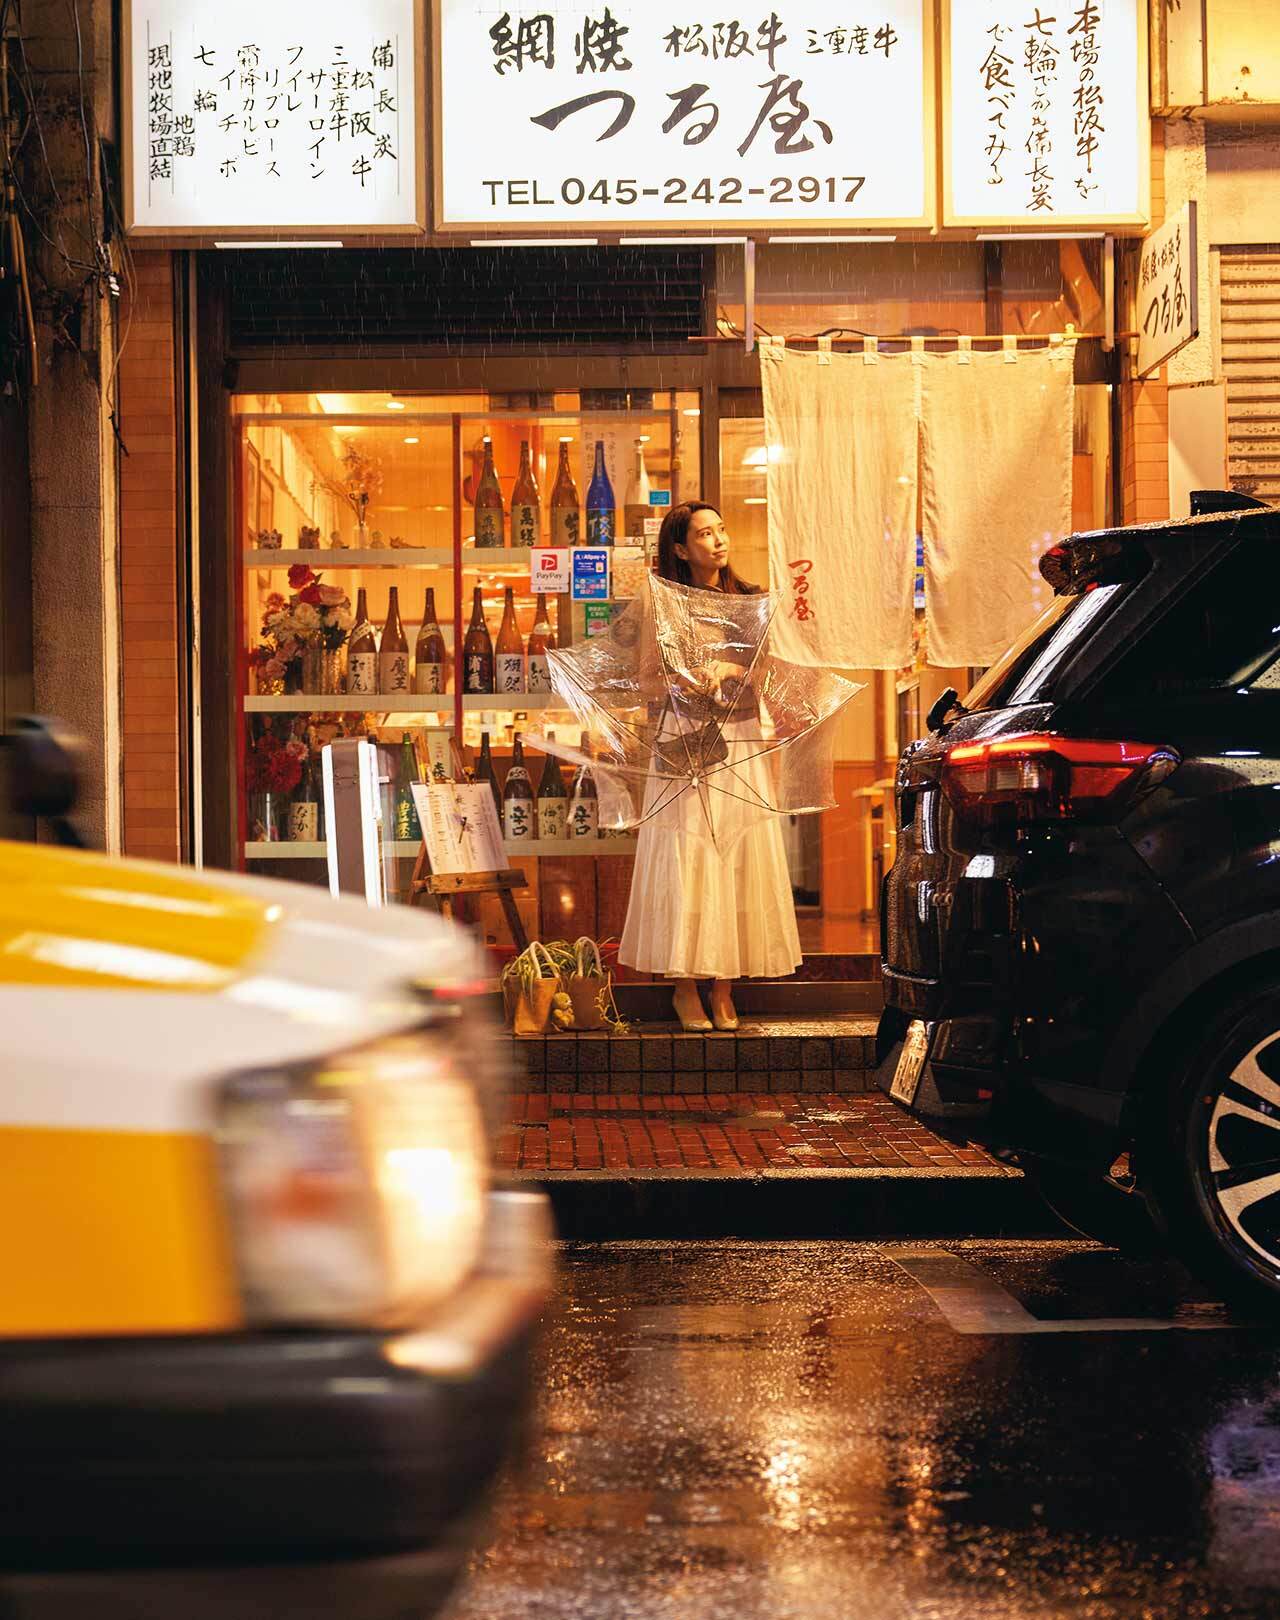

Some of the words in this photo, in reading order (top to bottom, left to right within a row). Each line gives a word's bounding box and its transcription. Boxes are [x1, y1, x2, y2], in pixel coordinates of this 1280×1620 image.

[193, 45, 218, 113] 七輪
[489, 6, 633, 76] 網焼
[662, 12, 788, 72] 松阪牛
[804, 25, 899, 58] 三重産牛
[149, 44, 173, 180] 現地牧場直結
[218, 70, 239, 178] イチボ
[237, 44, 261, 156] 霜降カルビ
[265, 69, 283, 178] リブロース
[307, 68, 327, 179] サーロイン
[329, 46, 350, 142] 三重産牛
[351, 68, 376, 187] 松阪牛
[372, 40, 397, 160] 備長炭
[530, 74, 833, 157] つる屋
[1067, 0, 1105, 199] 本場の松阪牛を
[482, 180, 555, 206] TEL
[561, 176, 867, 206] 045-242-2917
[1143, 263, 1187, 339] つる屋
[536, 572, 562, 580] PayPay
[788, 560, 815, 621] つる屋
[391, 656, 407, 691] 魔王
[510, 806, 528, 836] 辛口
[574, 805, 592, 836] 辛口
